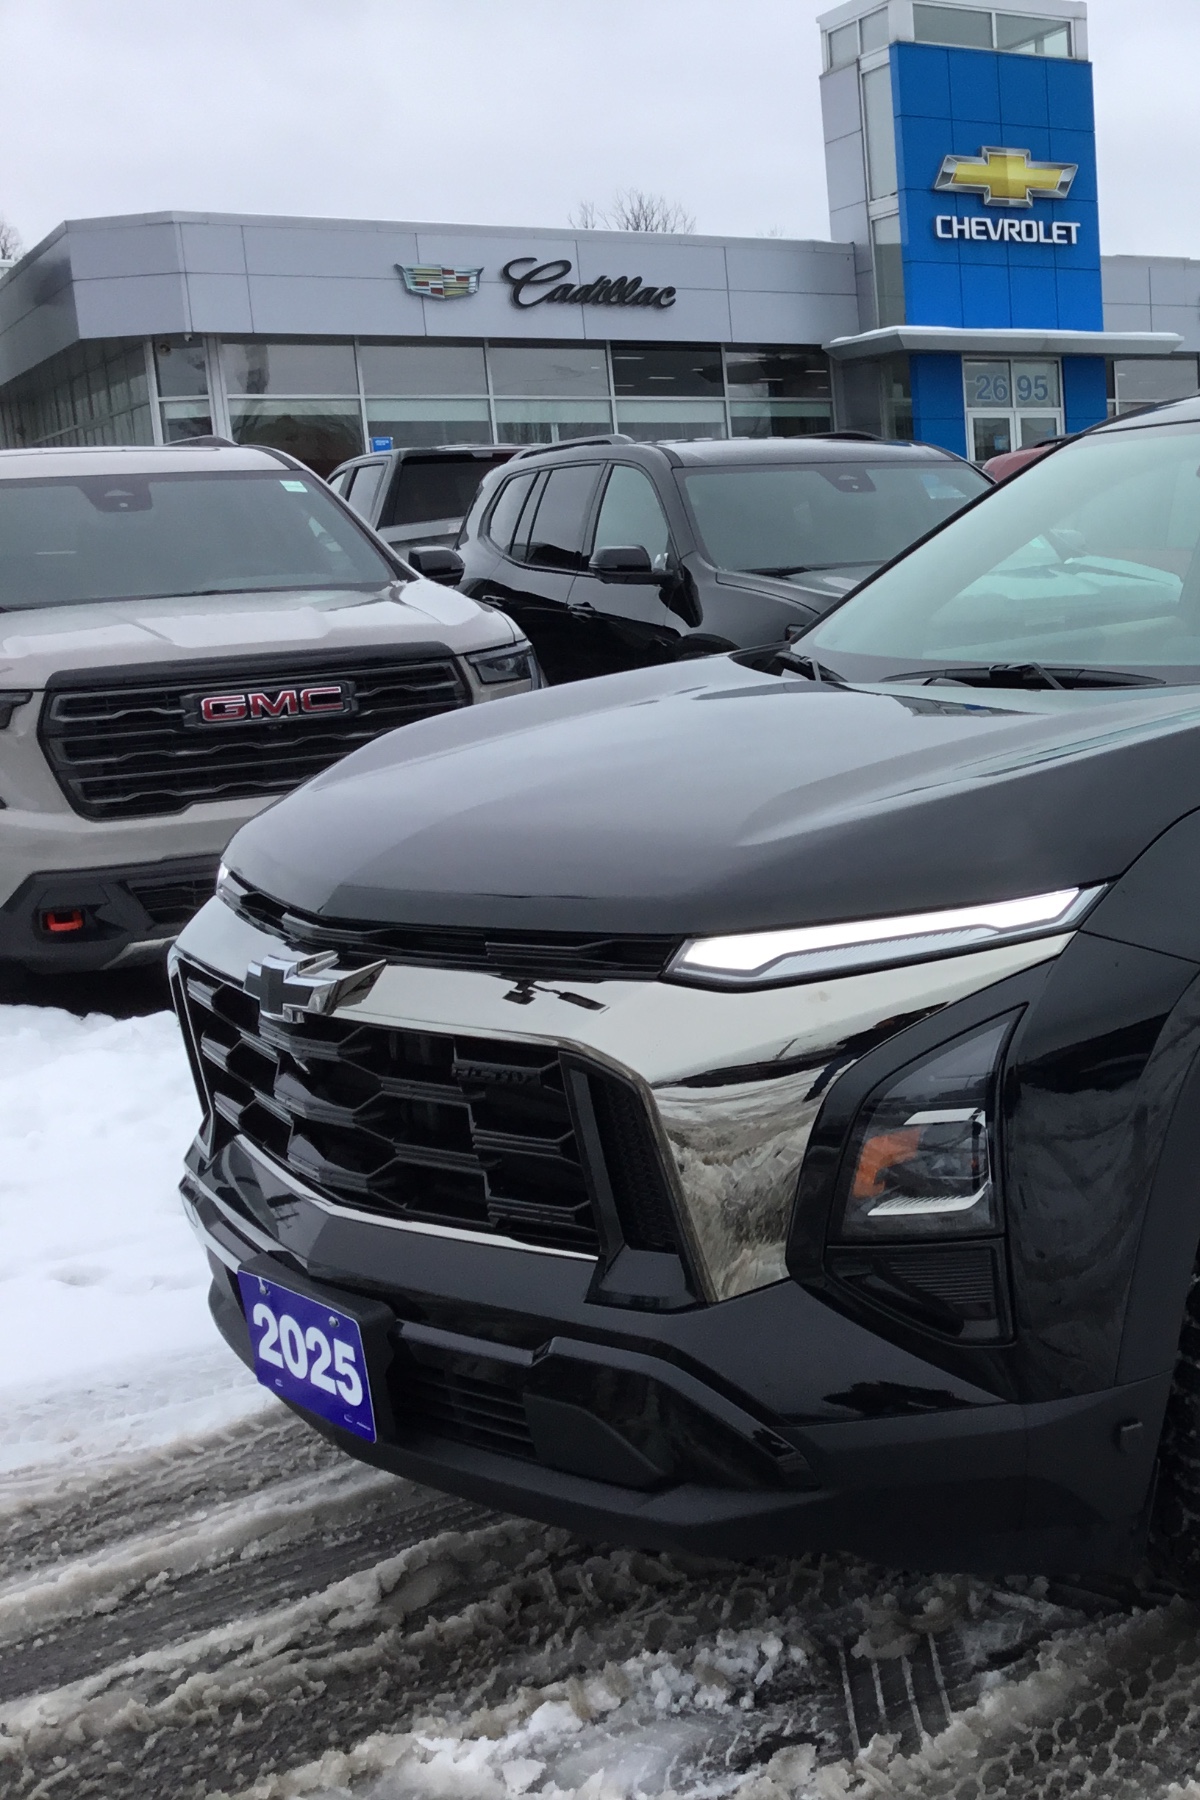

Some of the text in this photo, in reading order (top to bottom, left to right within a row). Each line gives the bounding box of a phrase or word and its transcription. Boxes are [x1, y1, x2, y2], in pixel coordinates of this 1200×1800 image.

[935, 214, 1081, 245] CHEVROLET
[502, 257, 677, 309] Cadillac
[201, 686, 345, 722] GMC
[253, 1303, 363, 1407] 2025
